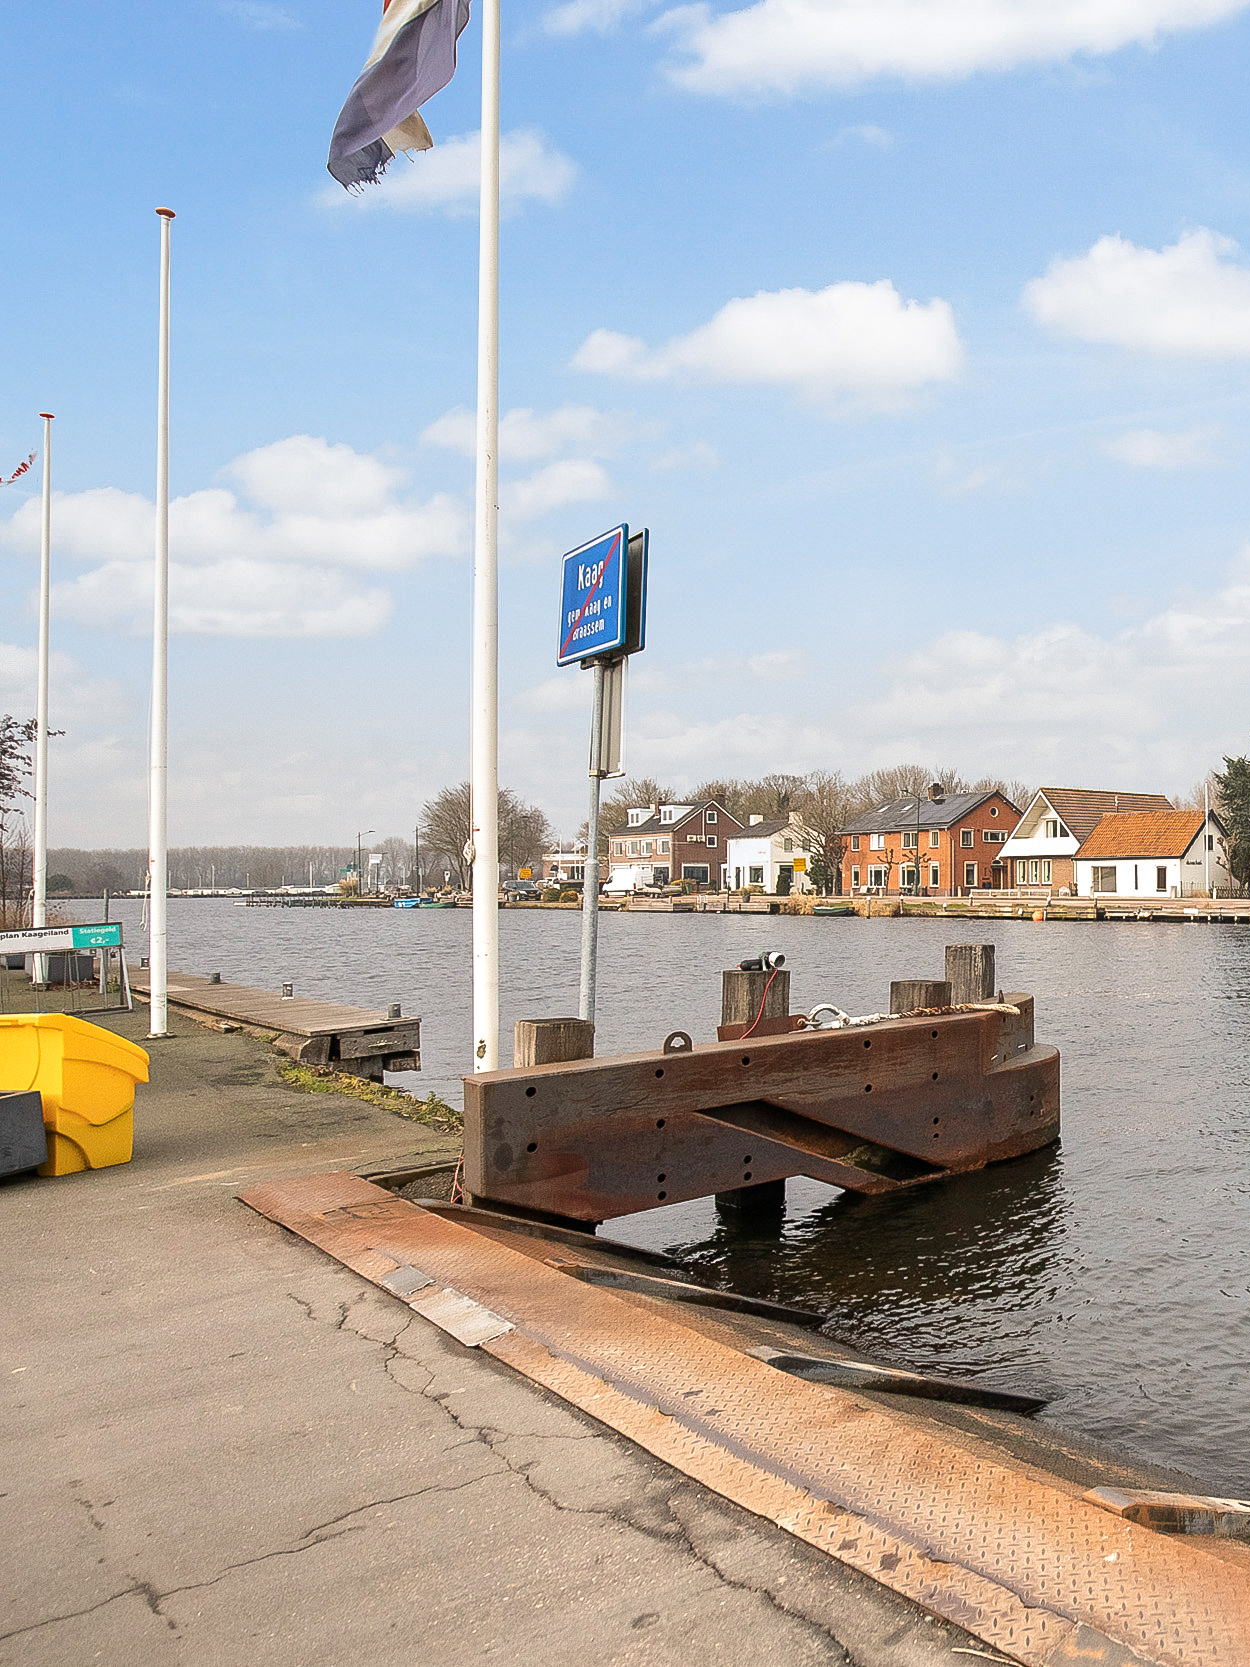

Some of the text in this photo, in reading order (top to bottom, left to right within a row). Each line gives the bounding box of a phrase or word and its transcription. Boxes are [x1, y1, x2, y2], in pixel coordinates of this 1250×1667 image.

[577, 560, 604, 591] Kaag
[603, 595, 612, 609] en
[0, 929, 70, 941] plan Kaageiland
[79, 926, 117, 935] Statiegeld
[90, 936, 110, 944] €2,-
